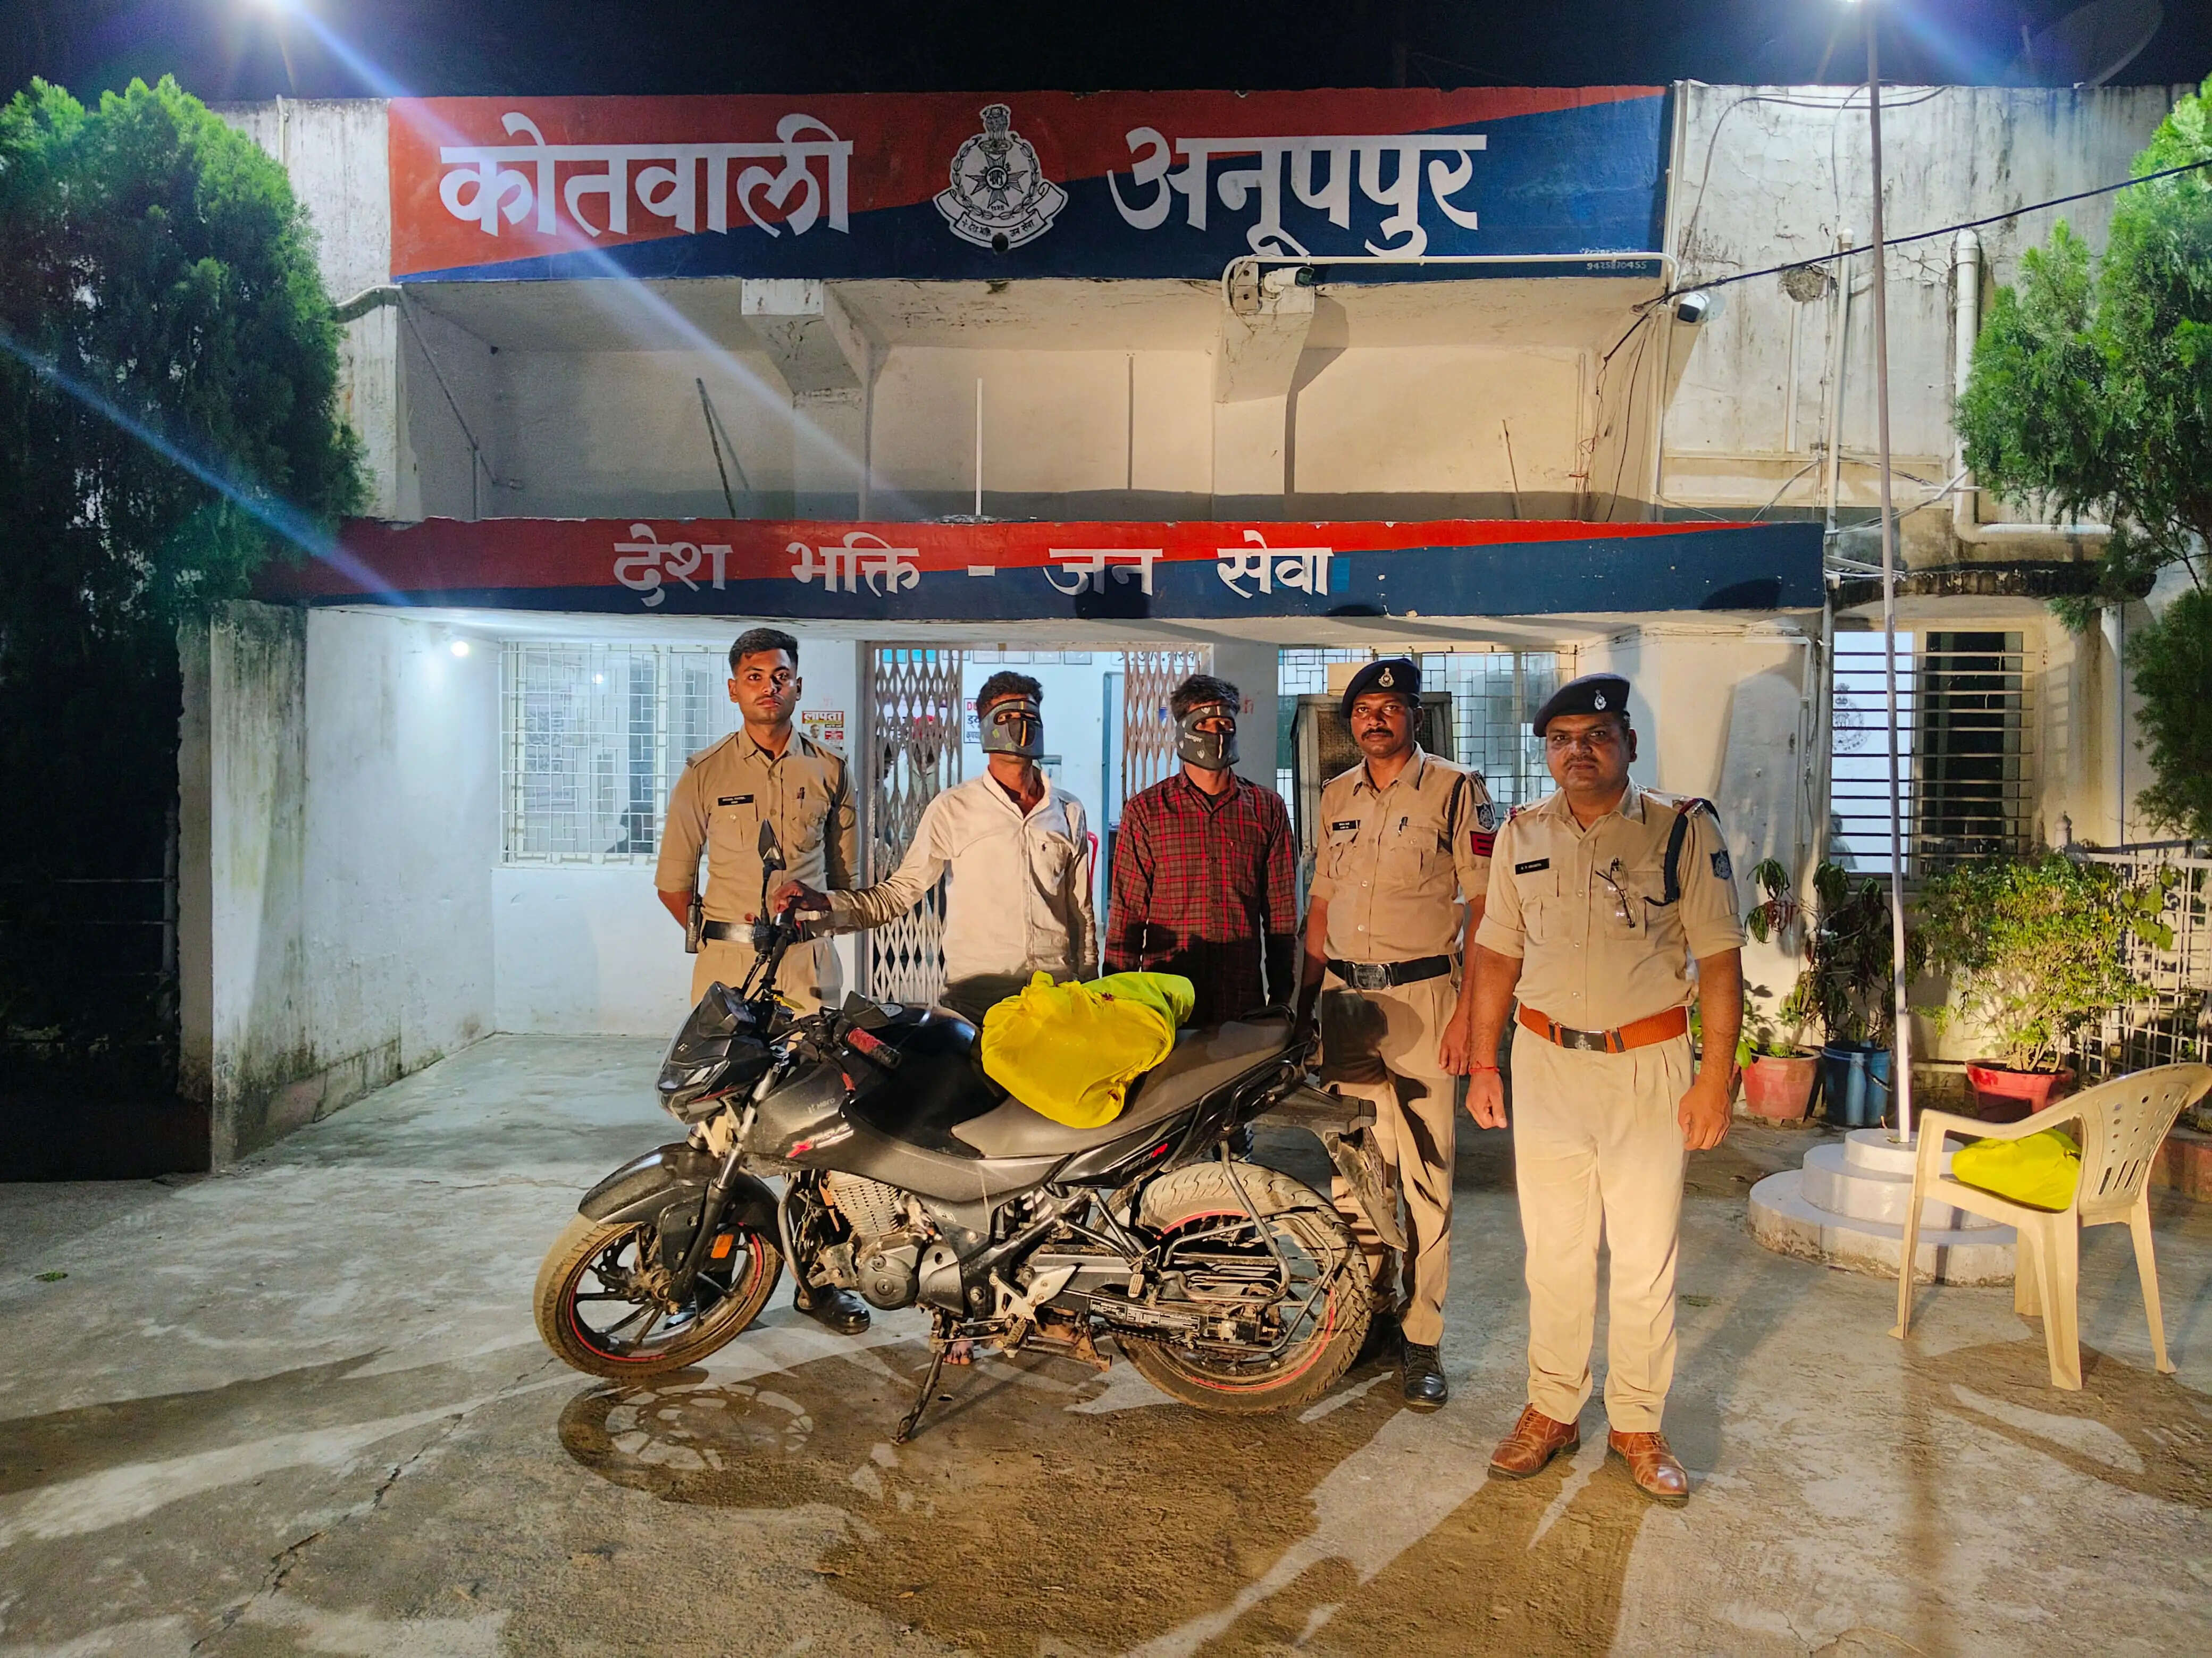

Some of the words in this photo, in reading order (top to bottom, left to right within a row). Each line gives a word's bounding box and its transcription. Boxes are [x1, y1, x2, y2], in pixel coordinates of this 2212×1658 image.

[439, 112, 853, 238] कोतवाली
[1108, 126, 1488, 257] अनूपपुर
[613, 524, 734, 607] देश
[786, 531, 920, 596] भक्ति
[1043, 548, 1163, 596] जन
[1217, 529, 1335, 599] सेवा
[803, 711, 843, 721] लापता
